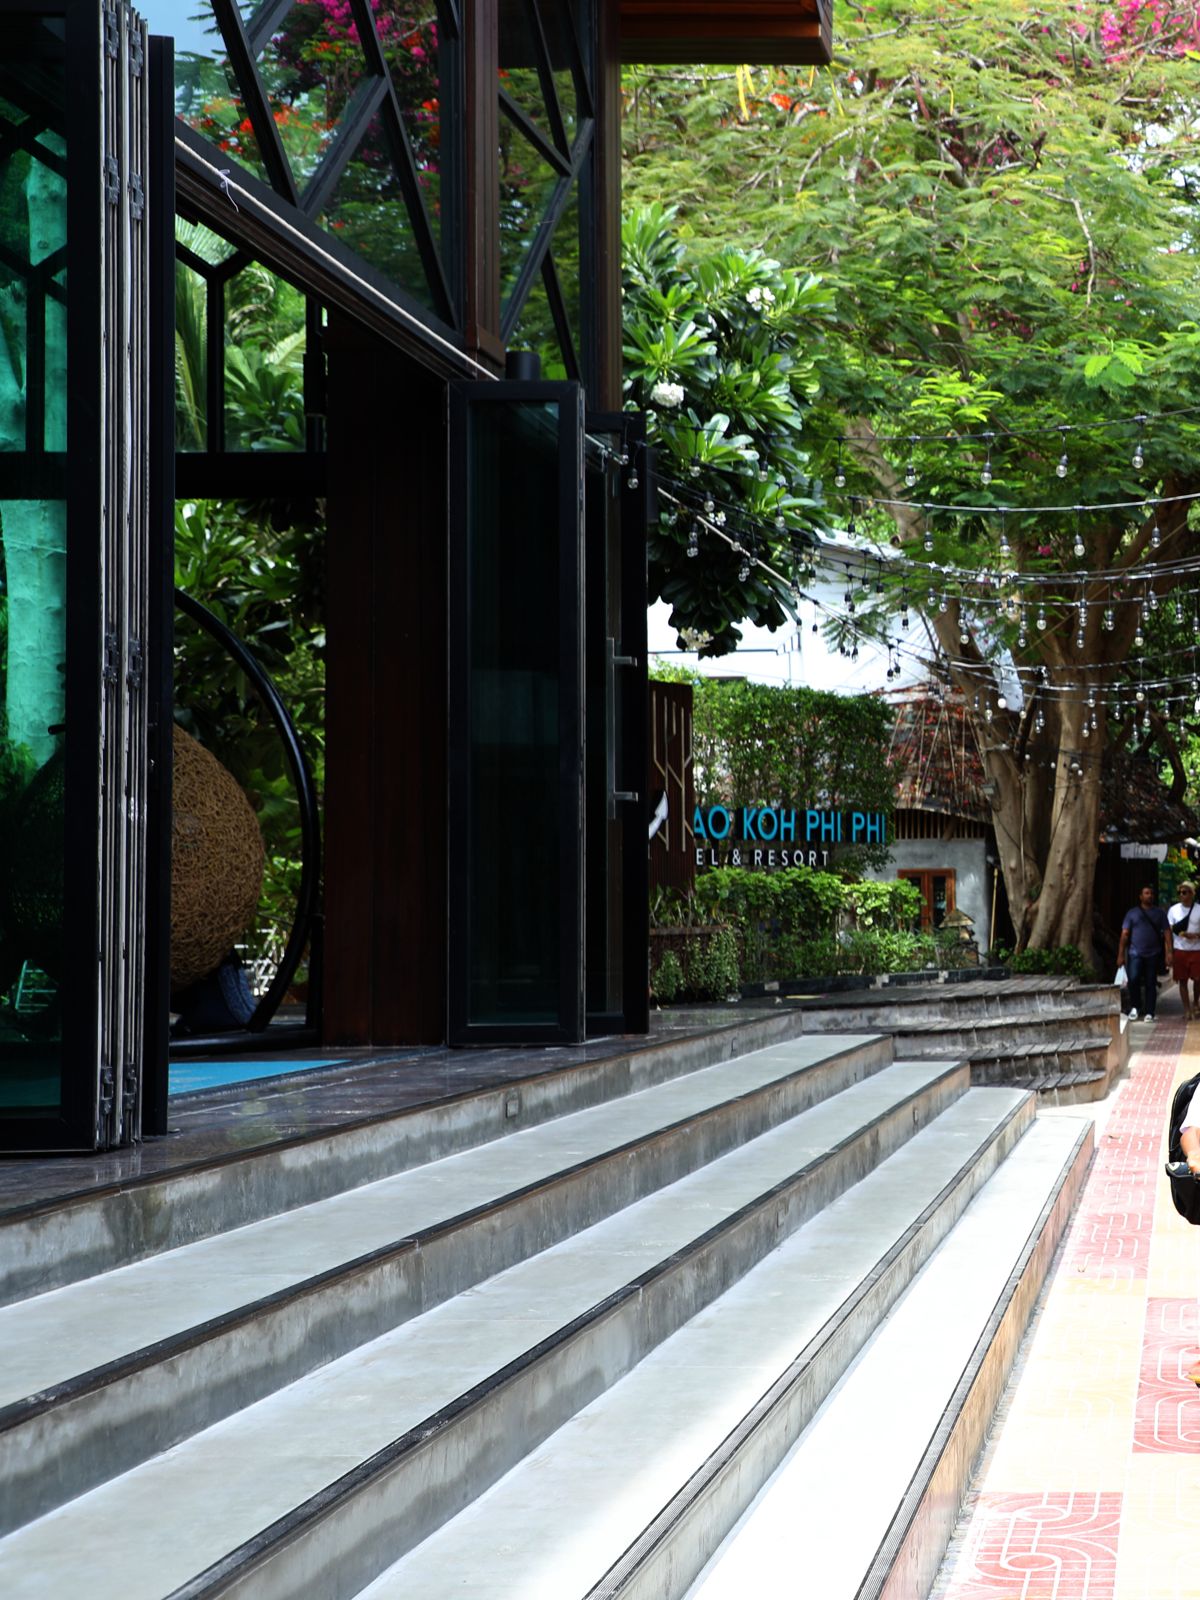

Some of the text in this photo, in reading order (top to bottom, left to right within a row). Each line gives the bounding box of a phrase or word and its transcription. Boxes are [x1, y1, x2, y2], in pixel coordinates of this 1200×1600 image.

[743, 807, 796, 842] KOH
[806, 810, 842, 843] PHI
[852, 811, 886, 844] PHI
[732, 848, 742, 866] &
[754, 850, 829, 867] RESORT
